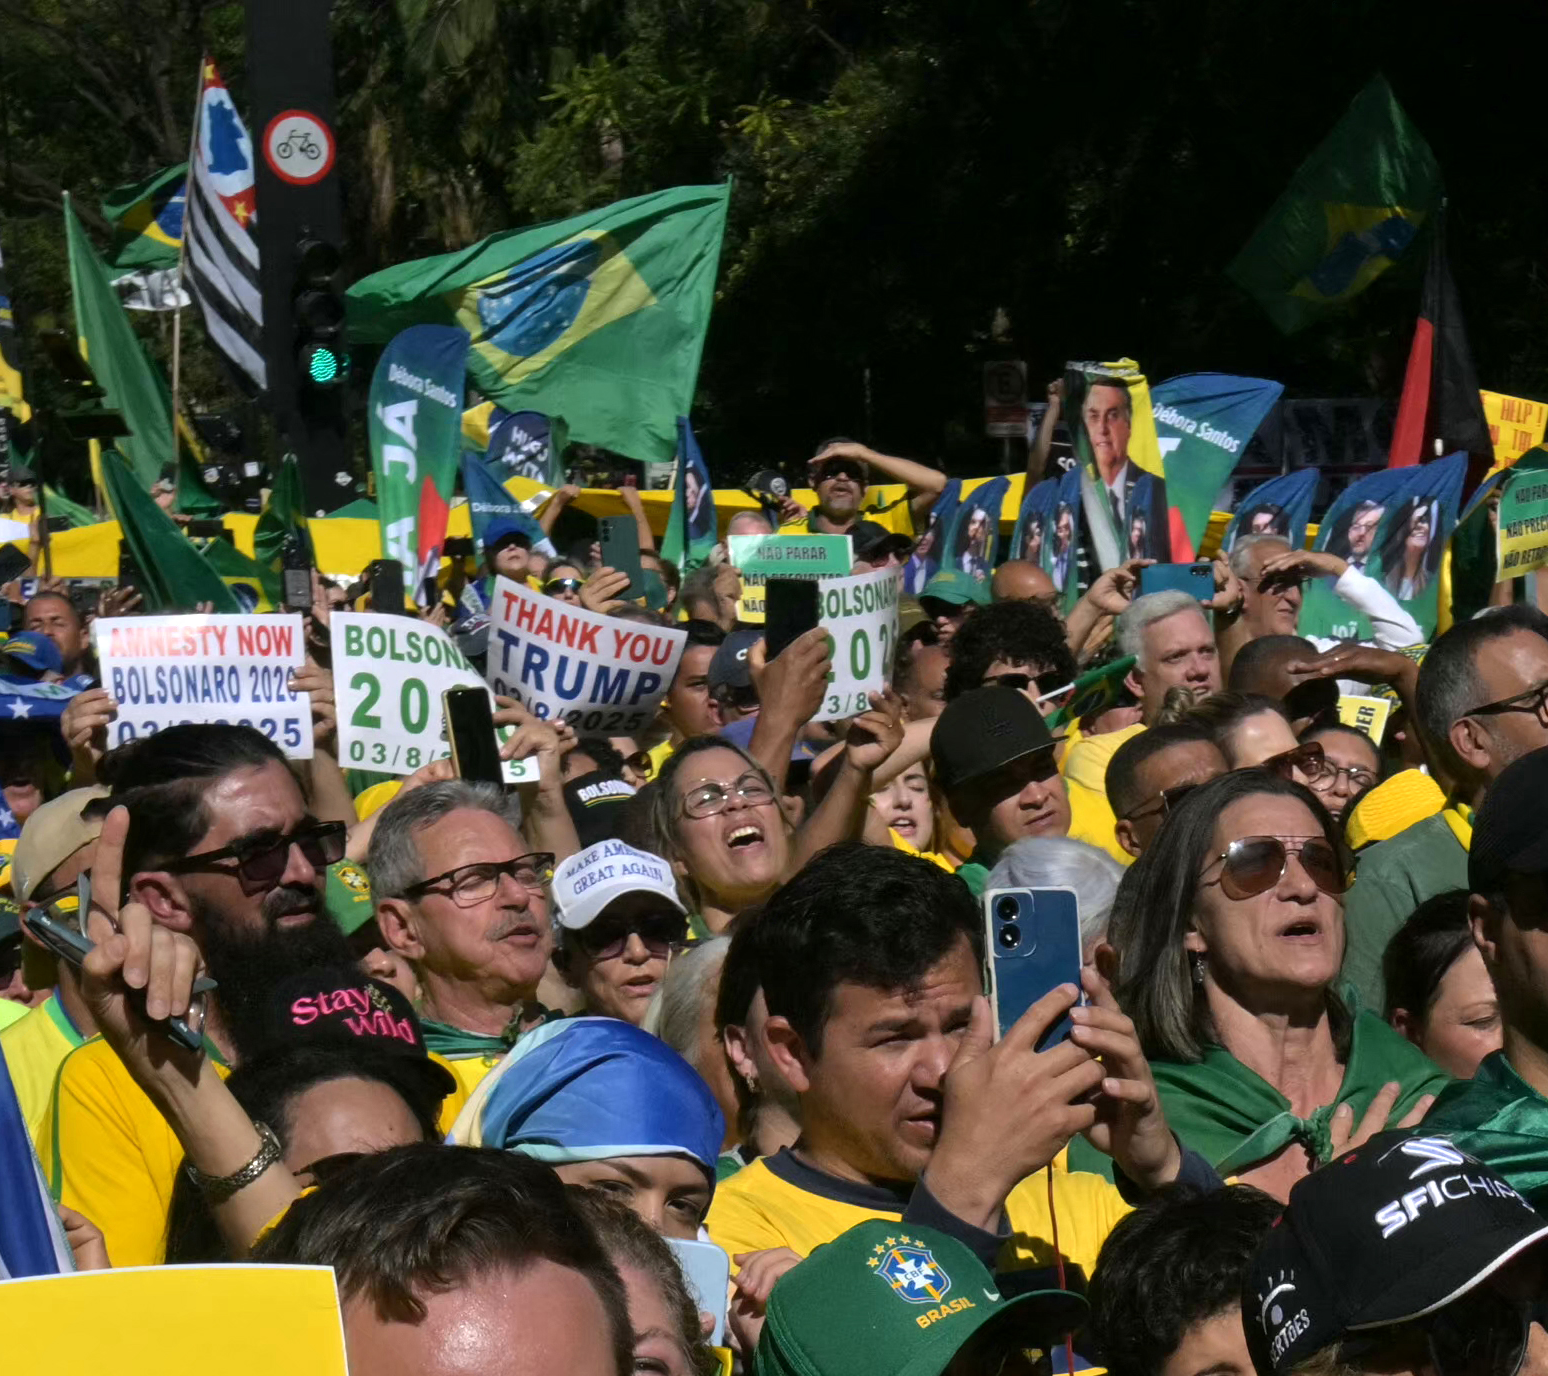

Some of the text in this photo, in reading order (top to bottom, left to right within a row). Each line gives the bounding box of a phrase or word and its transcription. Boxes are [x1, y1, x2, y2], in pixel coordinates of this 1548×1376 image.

[786, 546, 827, 561] PARAR
[109, 625, 294, 658] AMNESTY NOW
[502, 589, 675, 666] THANK YOU
[496, 628, 662, 706] TRUMP
[111, 664, 242, 705] BOLSONARO
[572, 862, 665, 896] GREAT AGAIN
[291, 986, 371, 1027] Stay
[903, 1267, 926, 1282] CBF
[915, 1296, 977, 1330] BRASIL
